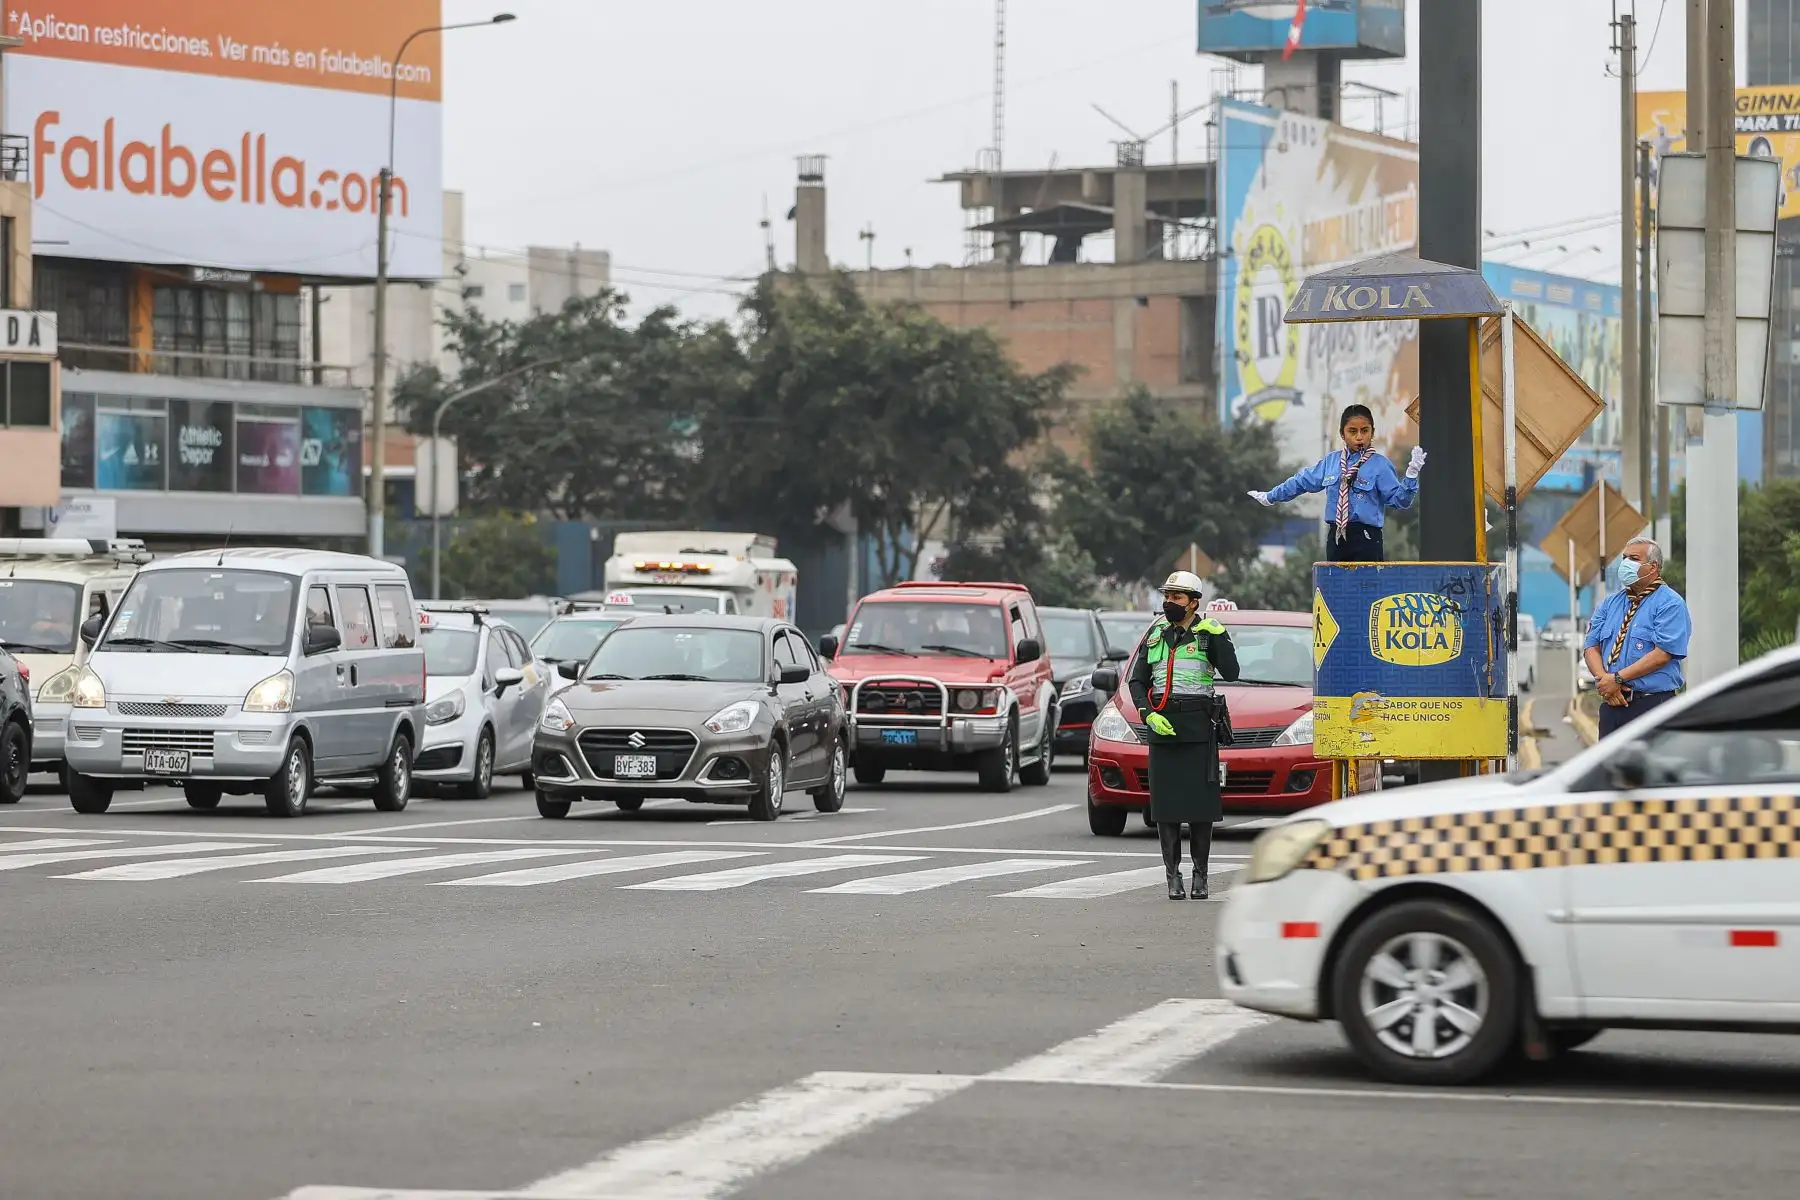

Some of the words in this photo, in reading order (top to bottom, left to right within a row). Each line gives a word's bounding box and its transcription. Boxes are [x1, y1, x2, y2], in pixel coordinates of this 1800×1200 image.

[94, 22, 214, 57] restricciones.
[217, 33, 249, 61] Ver
[252, 42, 290, 66] más
[294, 50, 316, 69] en
[319, 47, 431, 84] falabella.com
[34, 110, 409, 218] falabella.com
[1320, 285, 1435, 312] KOLA
[1211, 603, 1234, 611] TAXI
[1385, 629, 1449, 650] KOLA
[1382, 701, 1417, 709] SABOR
[1419, 701, 1439, 710] QUE
[1443, 701, 1463, 709] NOS
[1383, 713, 1410, 722] HACE
[1413, 712, 1451, 722] ÚNICOS
[147, 755, 187, 769] ATA-067
[616, 760, 655, 773] BYF-383
